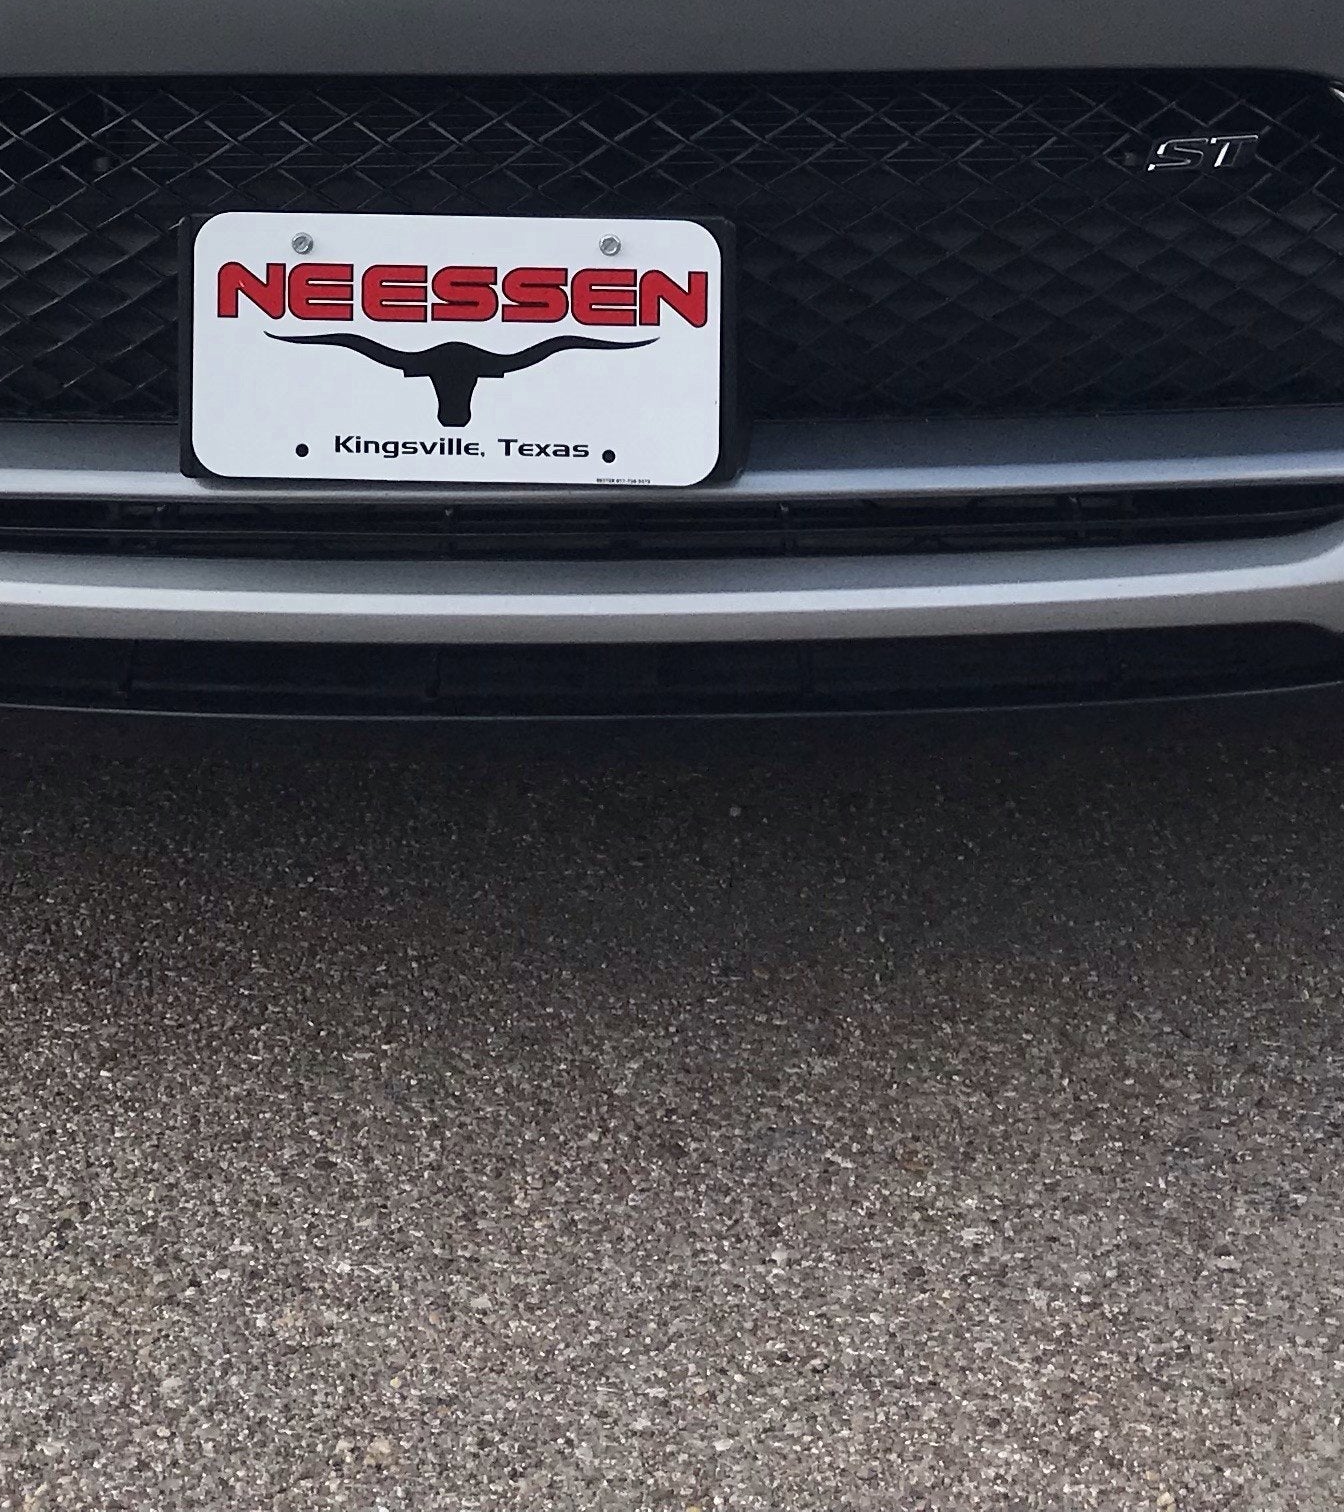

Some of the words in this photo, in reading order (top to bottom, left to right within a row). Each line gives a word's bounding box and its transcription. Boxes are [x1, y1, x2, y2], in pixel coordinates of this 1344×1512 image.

[1147, 134, 1259, 171] ST
[217, 261, 708, 329] NEESSEN
[334, 434, 485, 459] Kingsville,
[497, 438, 590, 458] Texas
